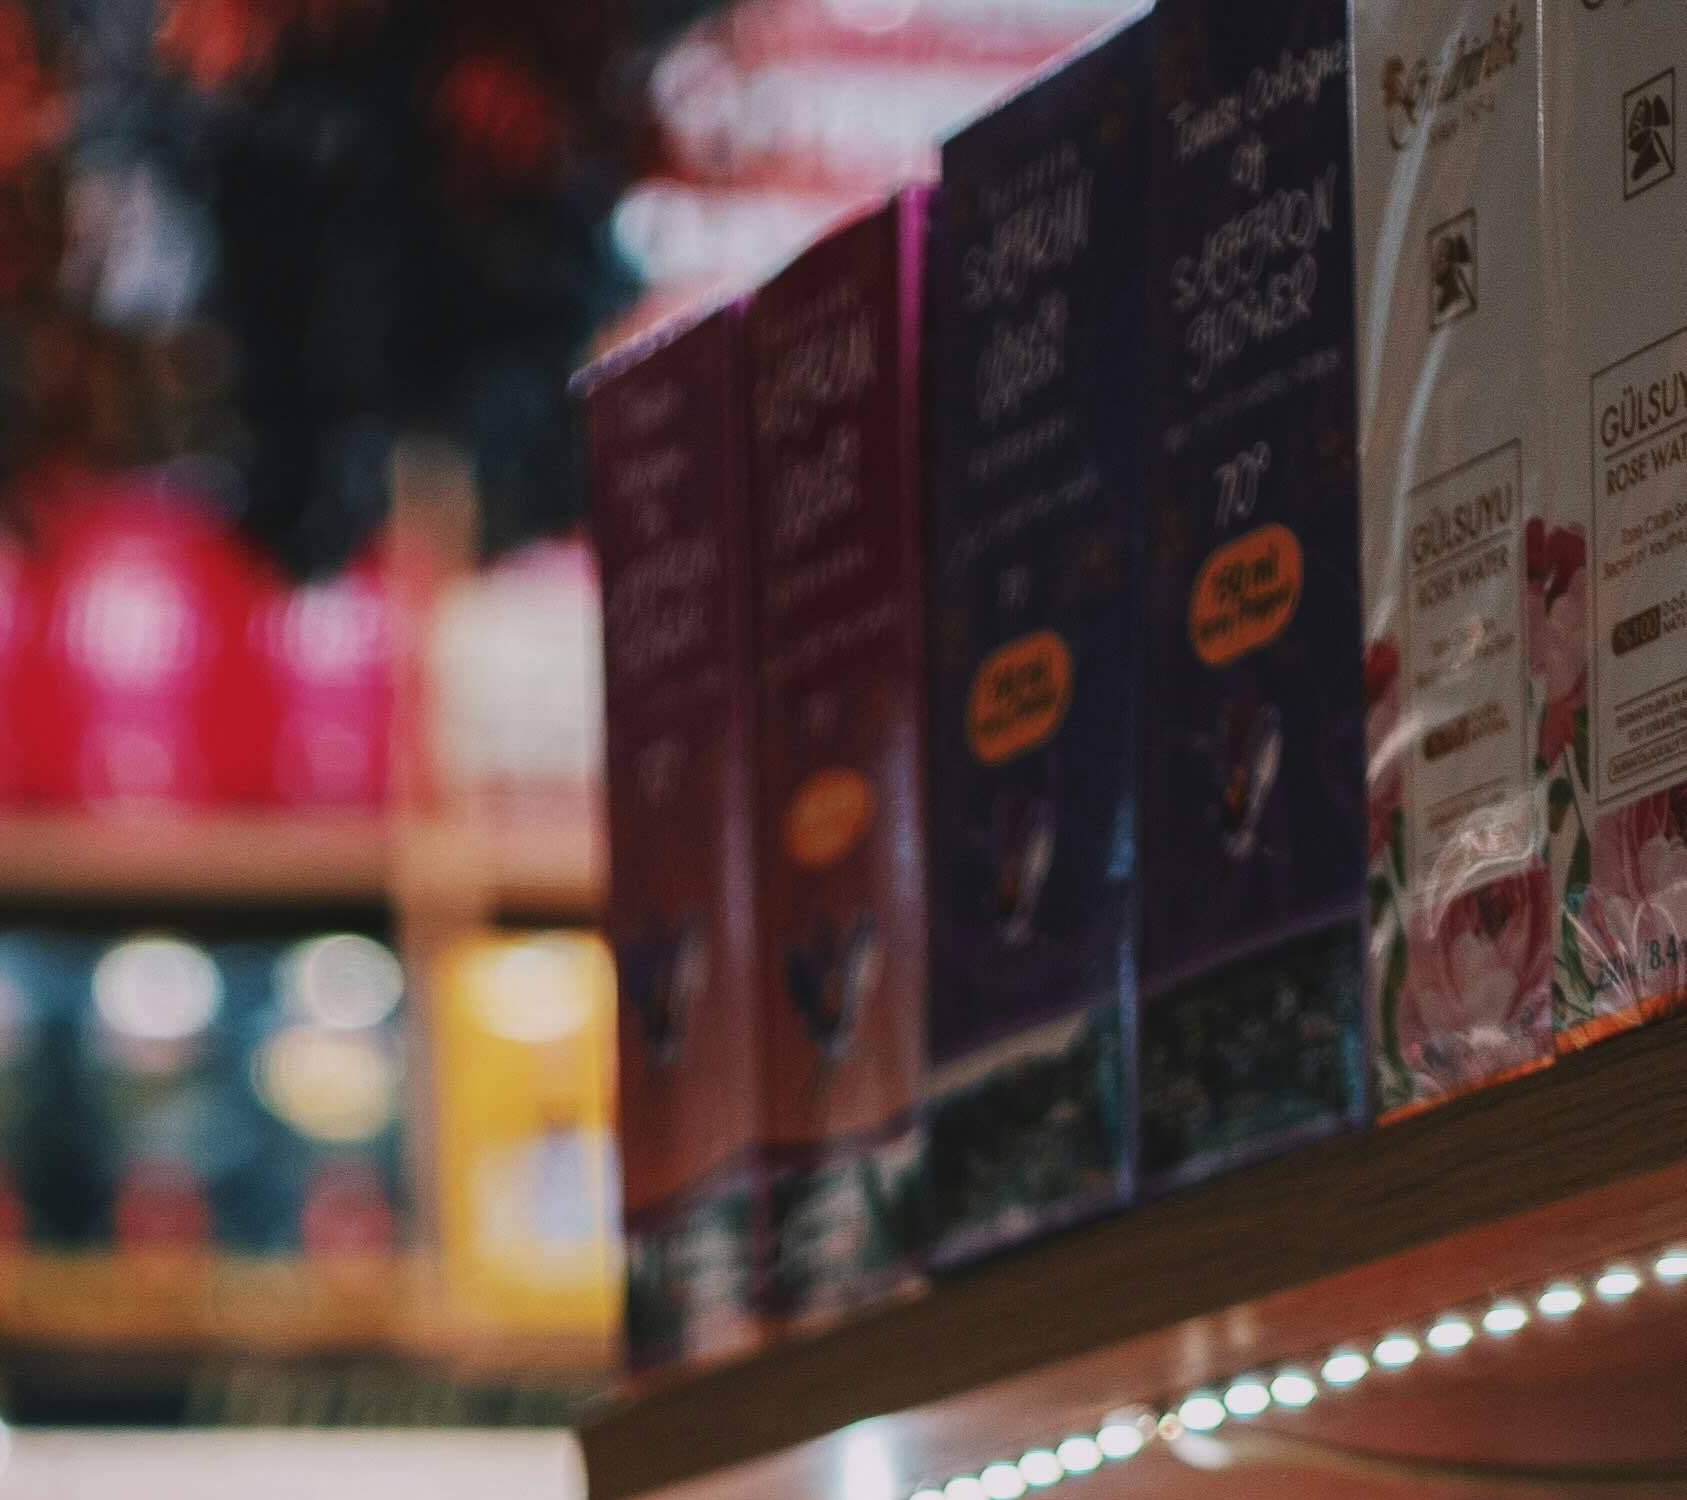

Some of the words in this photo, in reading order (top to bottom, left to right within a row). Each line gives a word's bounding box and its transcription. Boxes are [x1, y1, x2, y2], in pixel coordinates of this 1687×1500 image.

[1606, 452, 1649, 496] ROSE
[1414, 482, 1513, 564] GÜLSUYU
[1460, 543, 1510, 588] WATER
